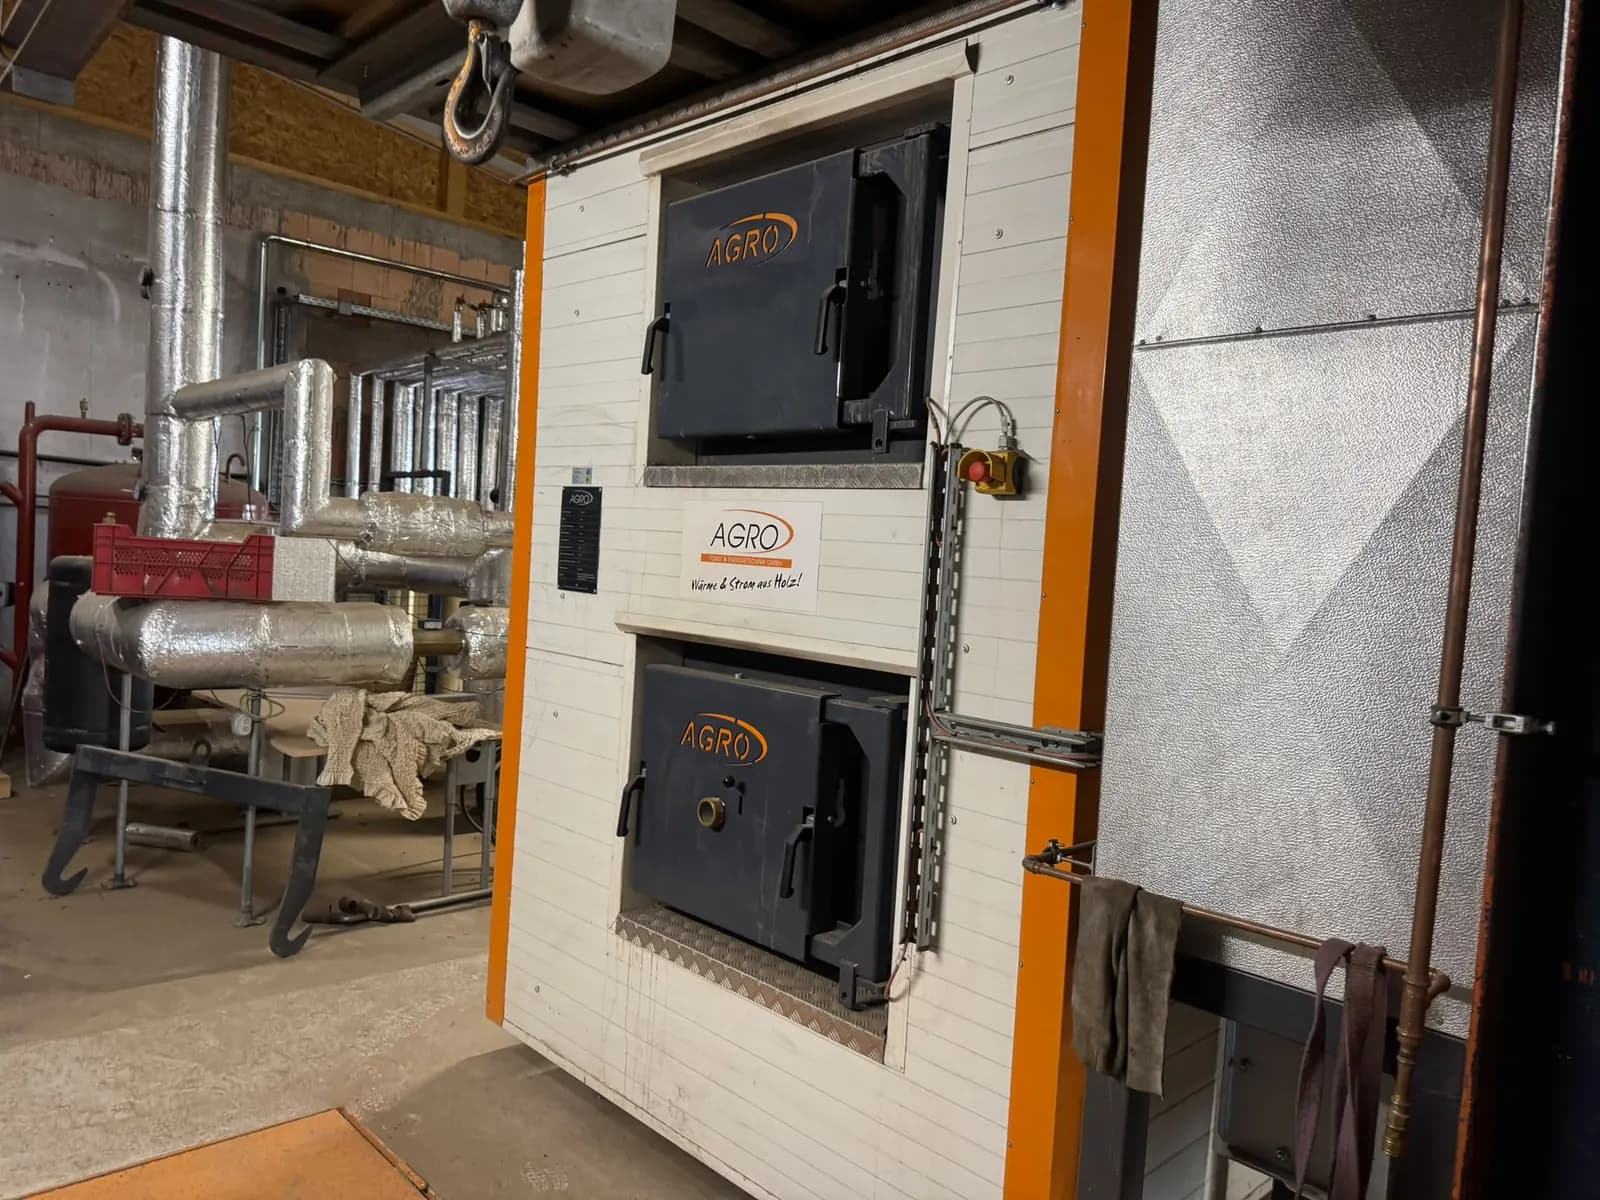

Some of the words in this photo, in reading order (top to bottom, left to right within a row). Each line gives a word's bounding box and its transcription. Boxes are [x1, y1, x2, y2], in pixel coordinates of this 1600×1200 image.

[705, 225, 780, 269] AGRO
[569, 494, 590, 504] AGRO
[710, 522, 779, 550] AGRO
[691, 578, 718, 592] Wärme
[719, 577, 727, 590] &
[729, 577, 756, 592] Strom
[757, 581, 772, 591] aus
[774, 572, 804, 589] Holz!
[680, 720, 751, 761] AGRO
